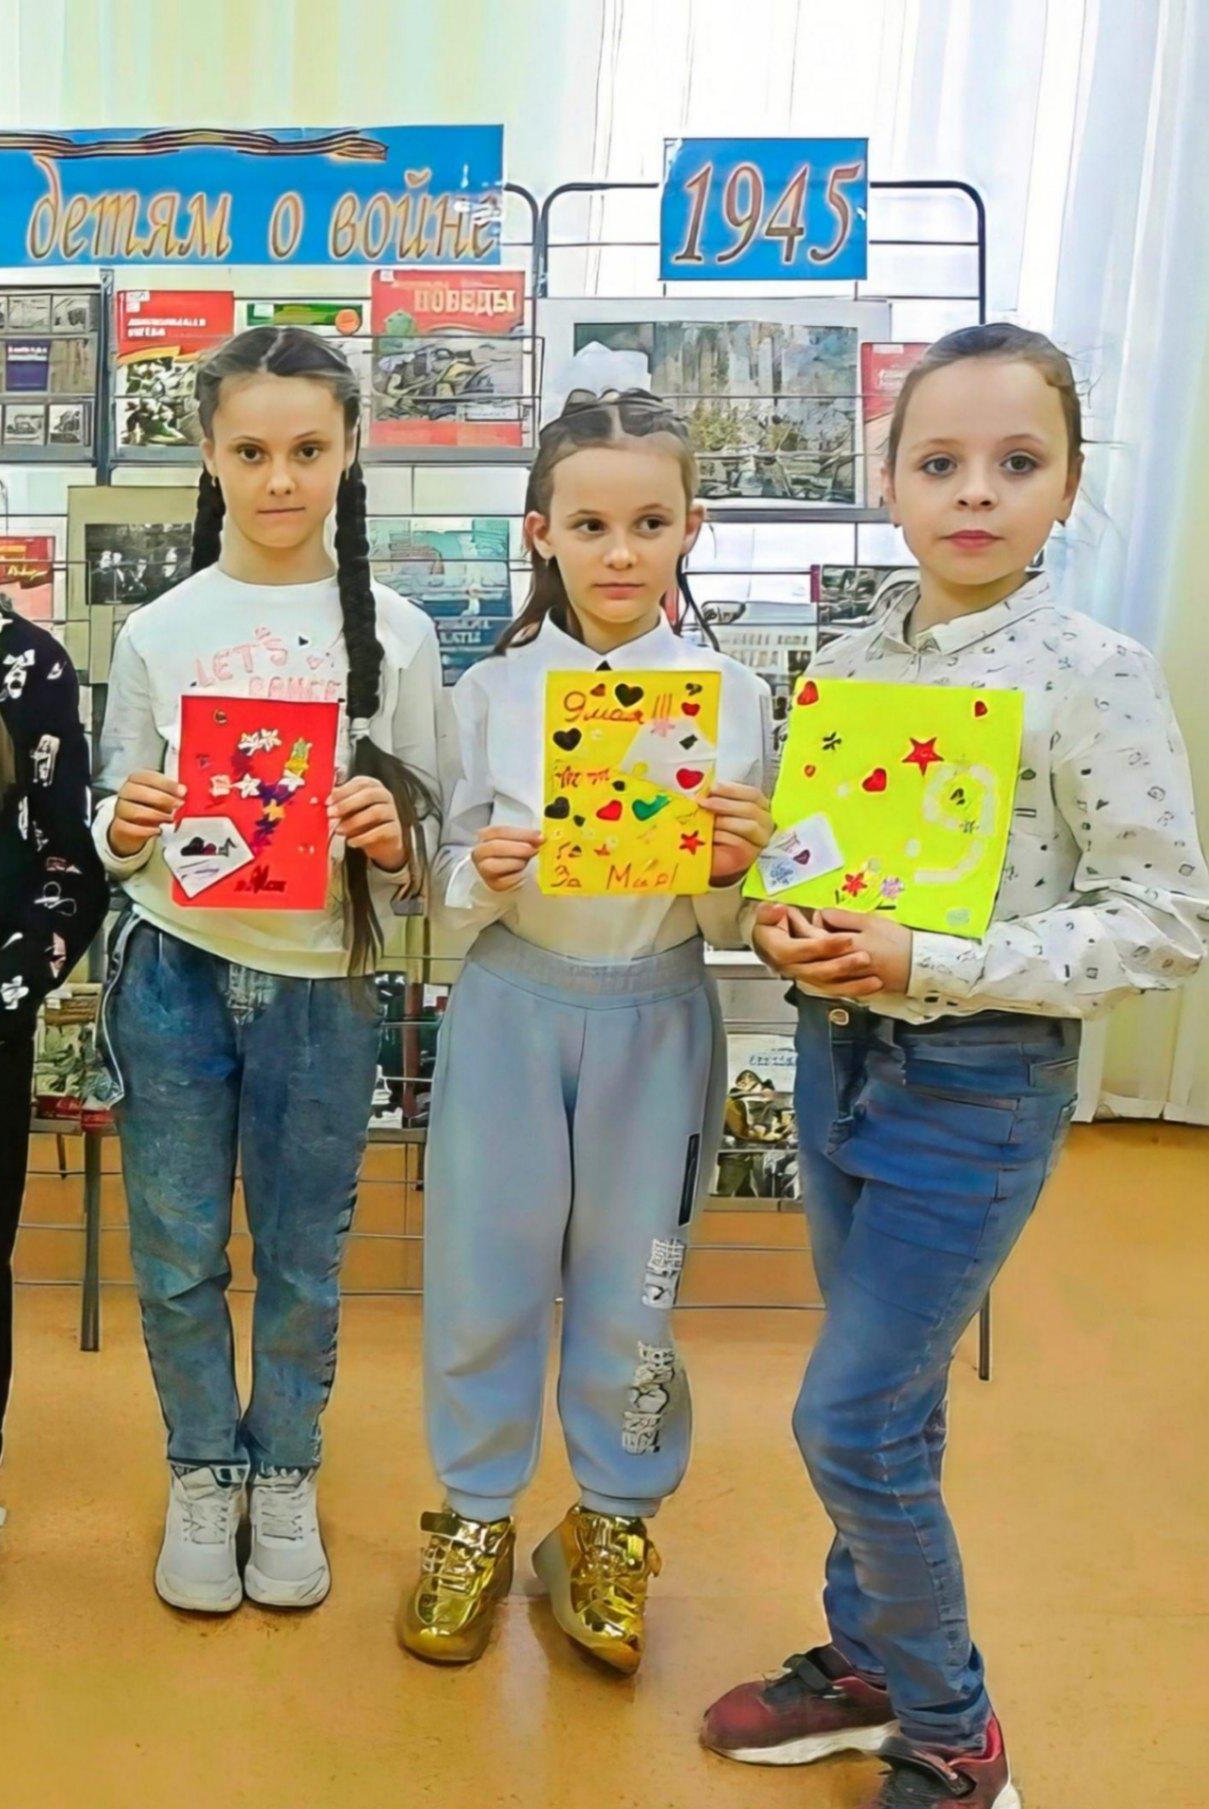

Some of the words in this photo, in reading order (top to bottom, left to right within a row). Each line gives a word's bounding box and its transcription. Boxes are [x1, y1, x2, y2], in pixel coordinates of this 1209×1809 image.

[28, 154, 233, 260] детям
[269, 191, 303, 260] о
[329, 168, 500, 259] войне
[673, 162, 862, 264] 1945
